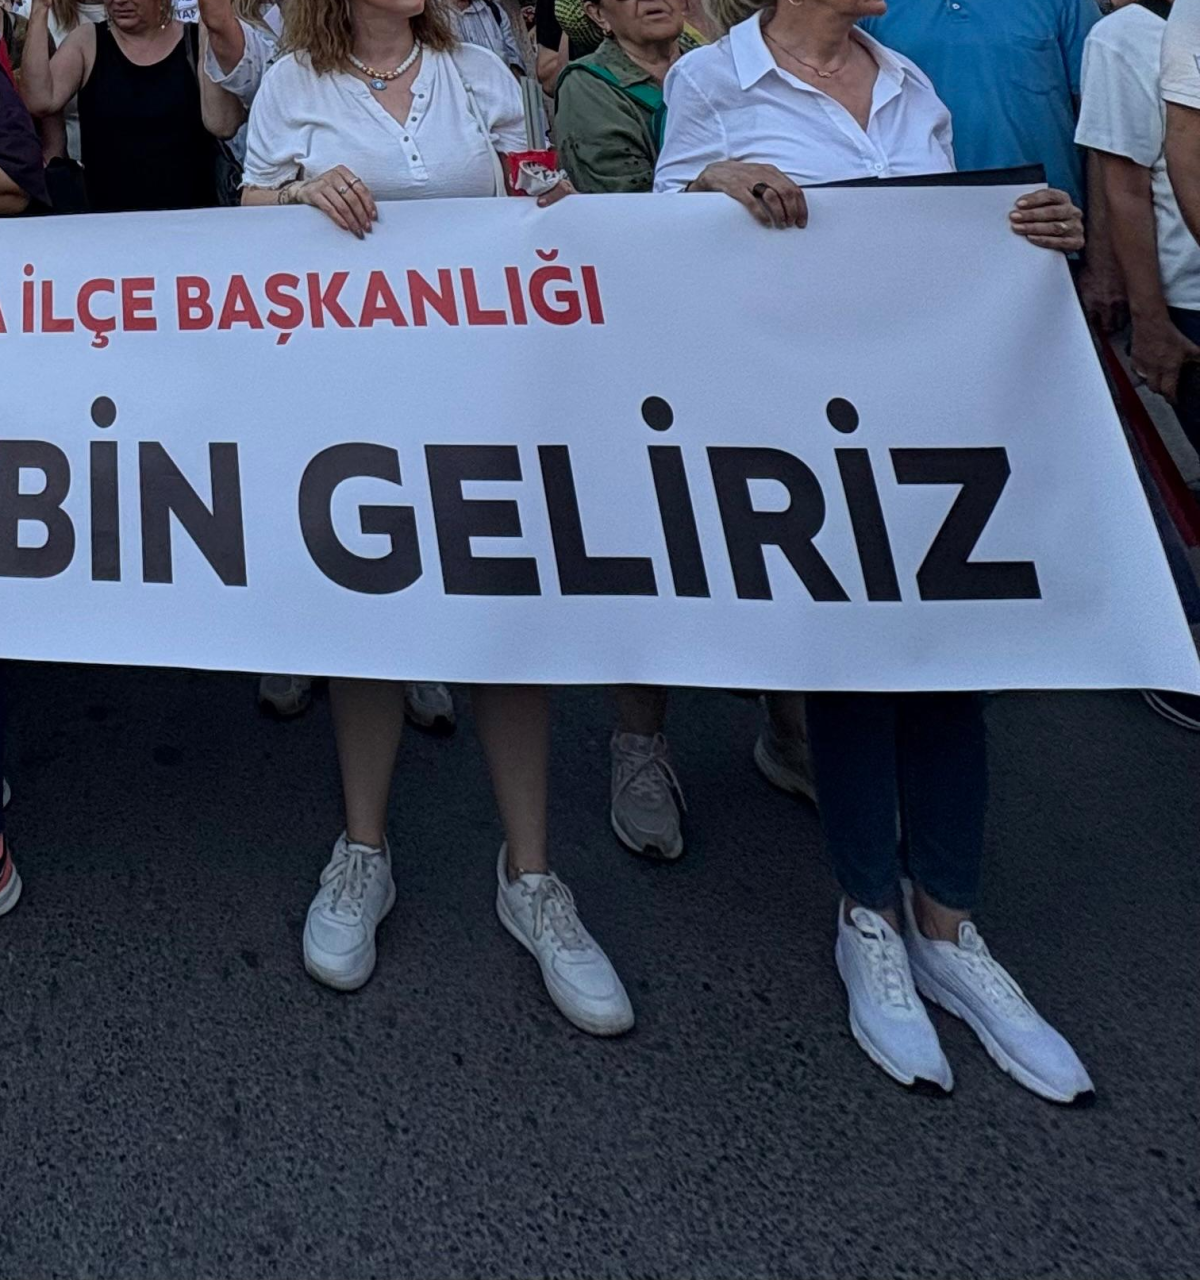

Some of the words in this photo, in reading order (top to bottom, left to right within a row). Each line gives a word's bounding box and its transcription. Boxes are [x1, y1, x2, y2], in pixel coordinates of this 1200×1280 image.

[22, 263, 157, 348] İLÇE
[175, 248, 604, 346] BAŞKANLIĞI
[298, 395, 1043, 603] GELİRİZ
